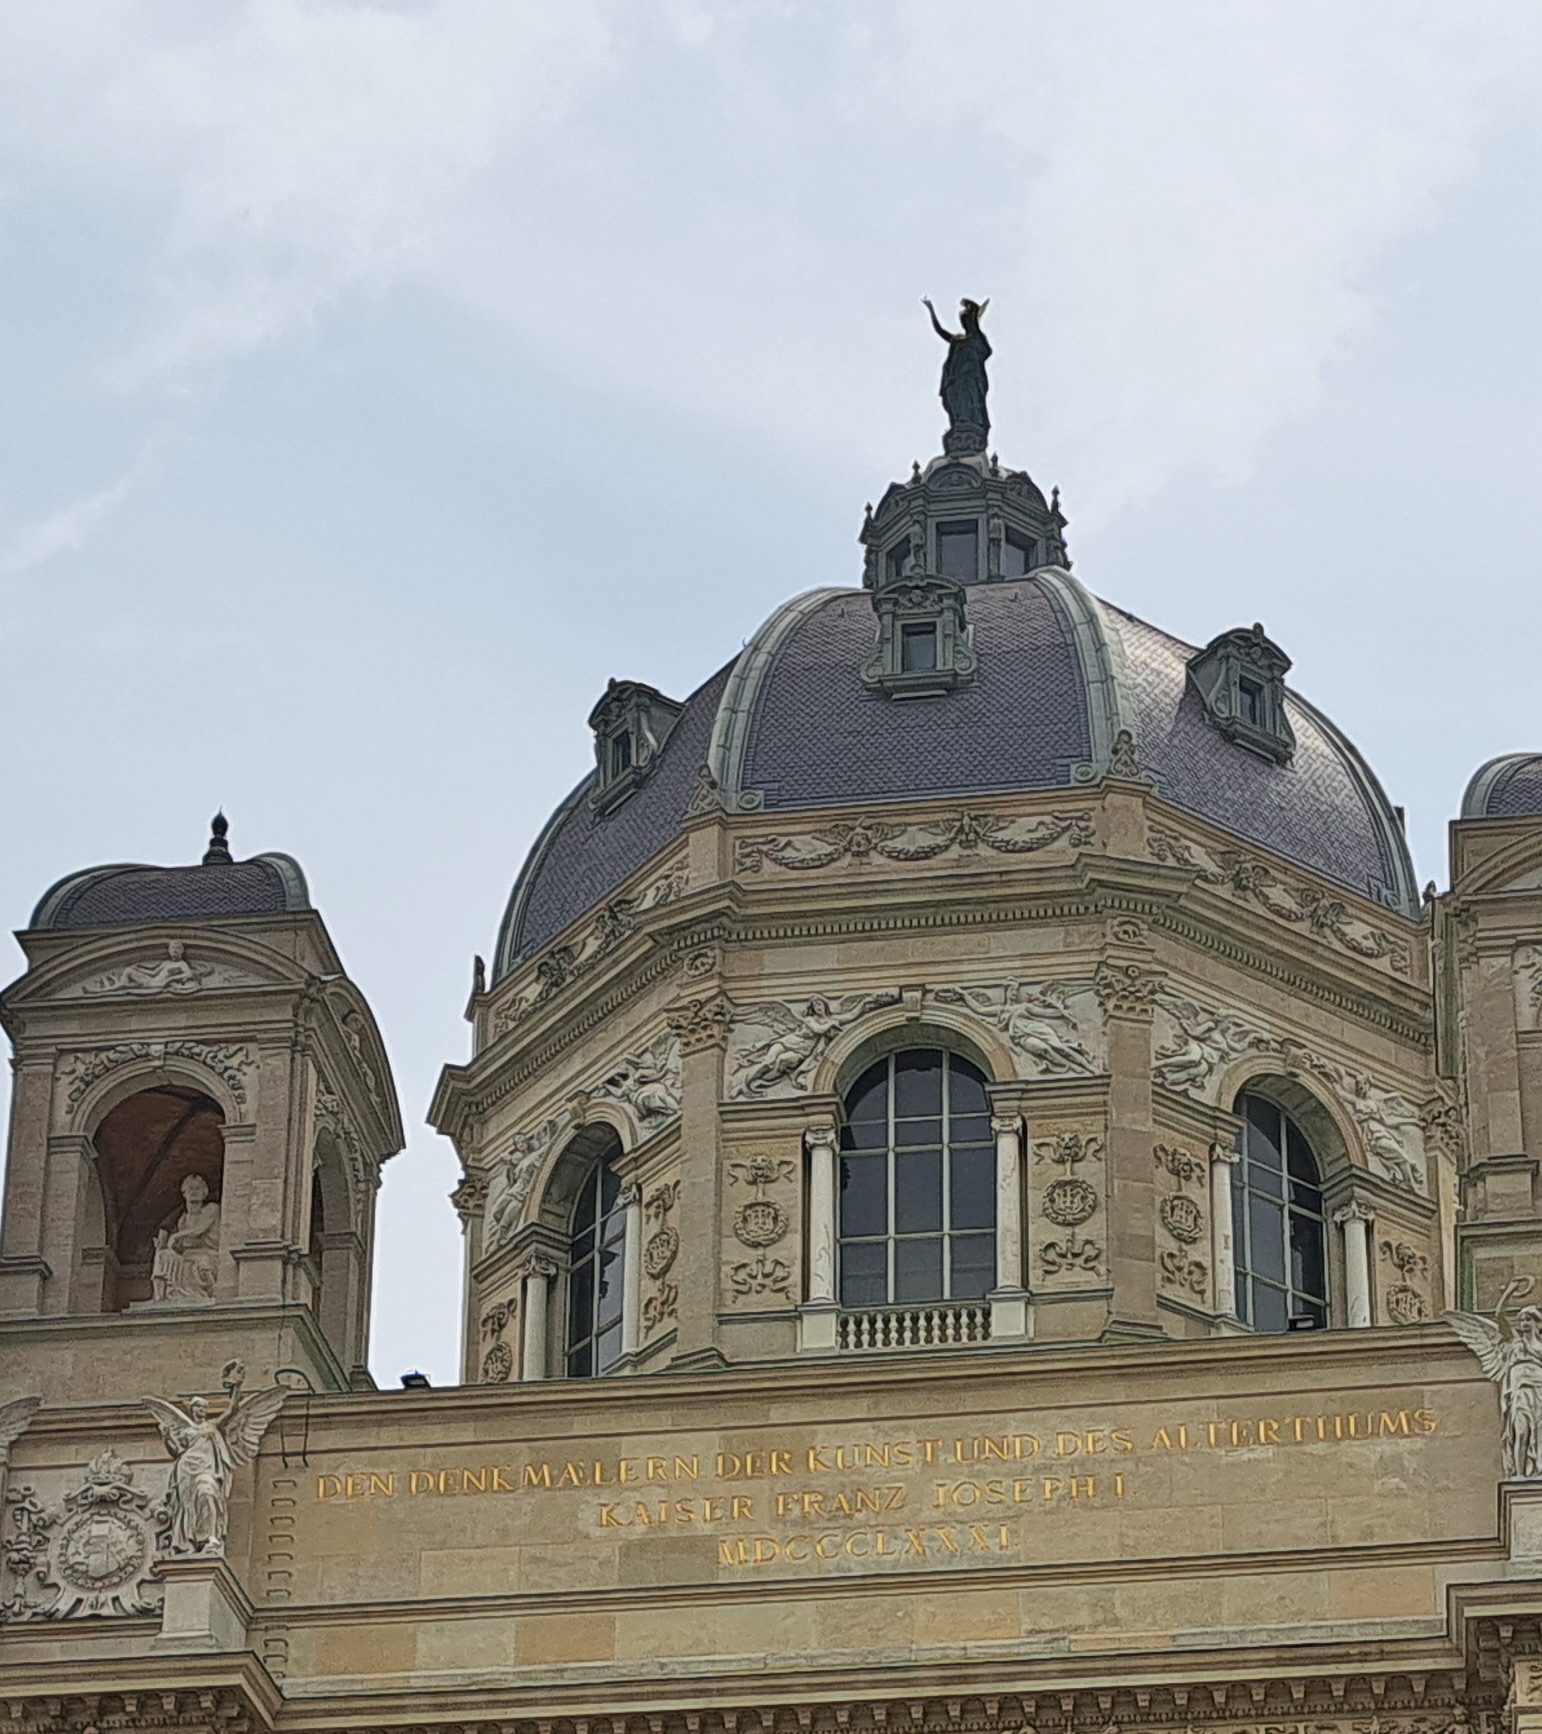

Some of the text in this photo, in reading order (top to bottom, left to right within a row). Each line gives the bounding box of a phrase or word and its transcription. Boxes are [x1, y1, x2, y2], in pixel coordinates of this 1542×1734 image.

[316, 1473, 395, 1499] DEN
[714, 1449, 793, 1479] DER
[808, 1438, 943, 1474] KUNST
[955, 1434, 1041, 1464] UND
[1055, 1427, 1134, 1458] DES
[1151, 1407, 1439, 1451] ALTERTHUMS
[597, 1472, 1140, 1528] KAISER FRANZ JOSEPH I.
